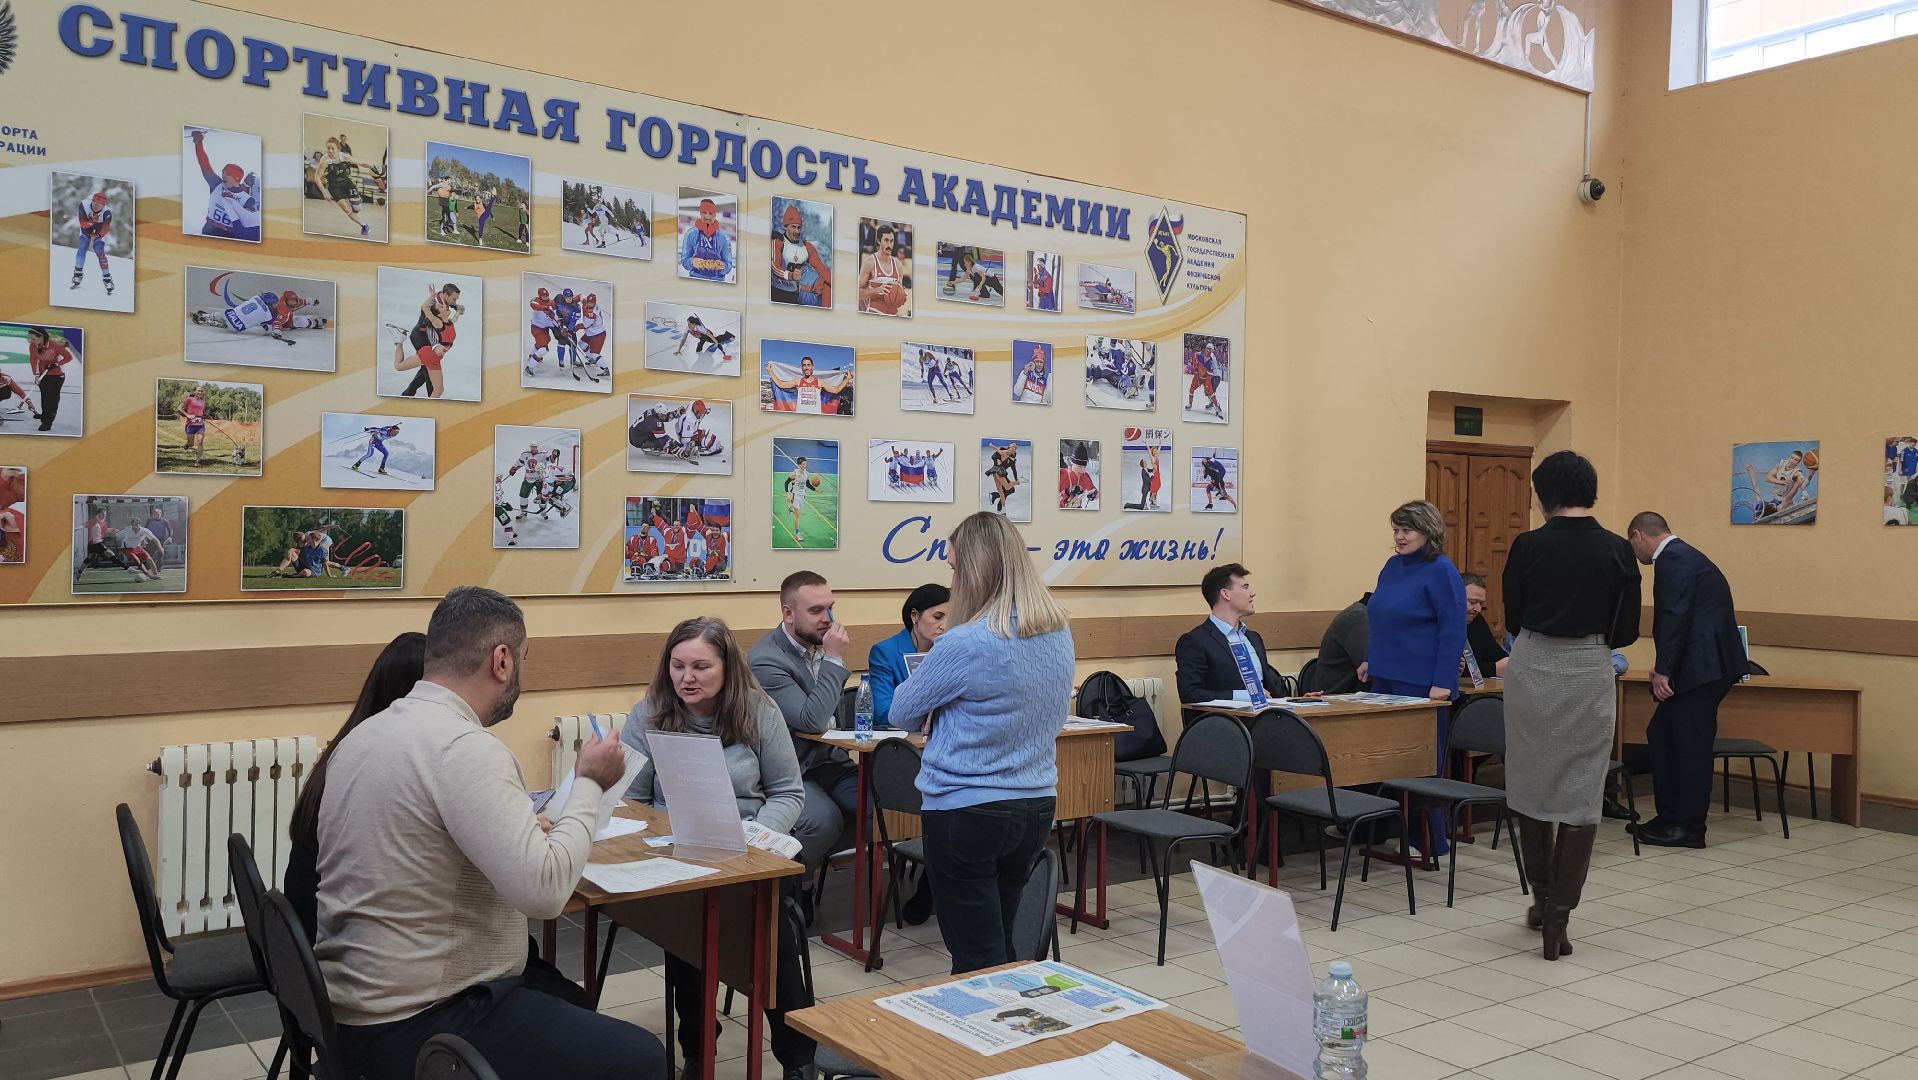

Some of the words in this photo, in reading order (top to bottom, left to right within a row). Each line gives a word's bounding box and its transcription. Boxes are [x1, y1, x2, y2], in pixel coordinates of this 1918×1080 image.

[58, 4, 580, 144] СПОРТИВНАЯ
[606, 107, 880, 196] ГОРДОСТЬ
[898, 166, 1131, 240] АКАДЕМИИ
[1187, 233, 1222, 245] МОСКОВСКАЯ
[1053, 538, 1110, 561] это
[1119, 527, 1225, 561] жизнь!
